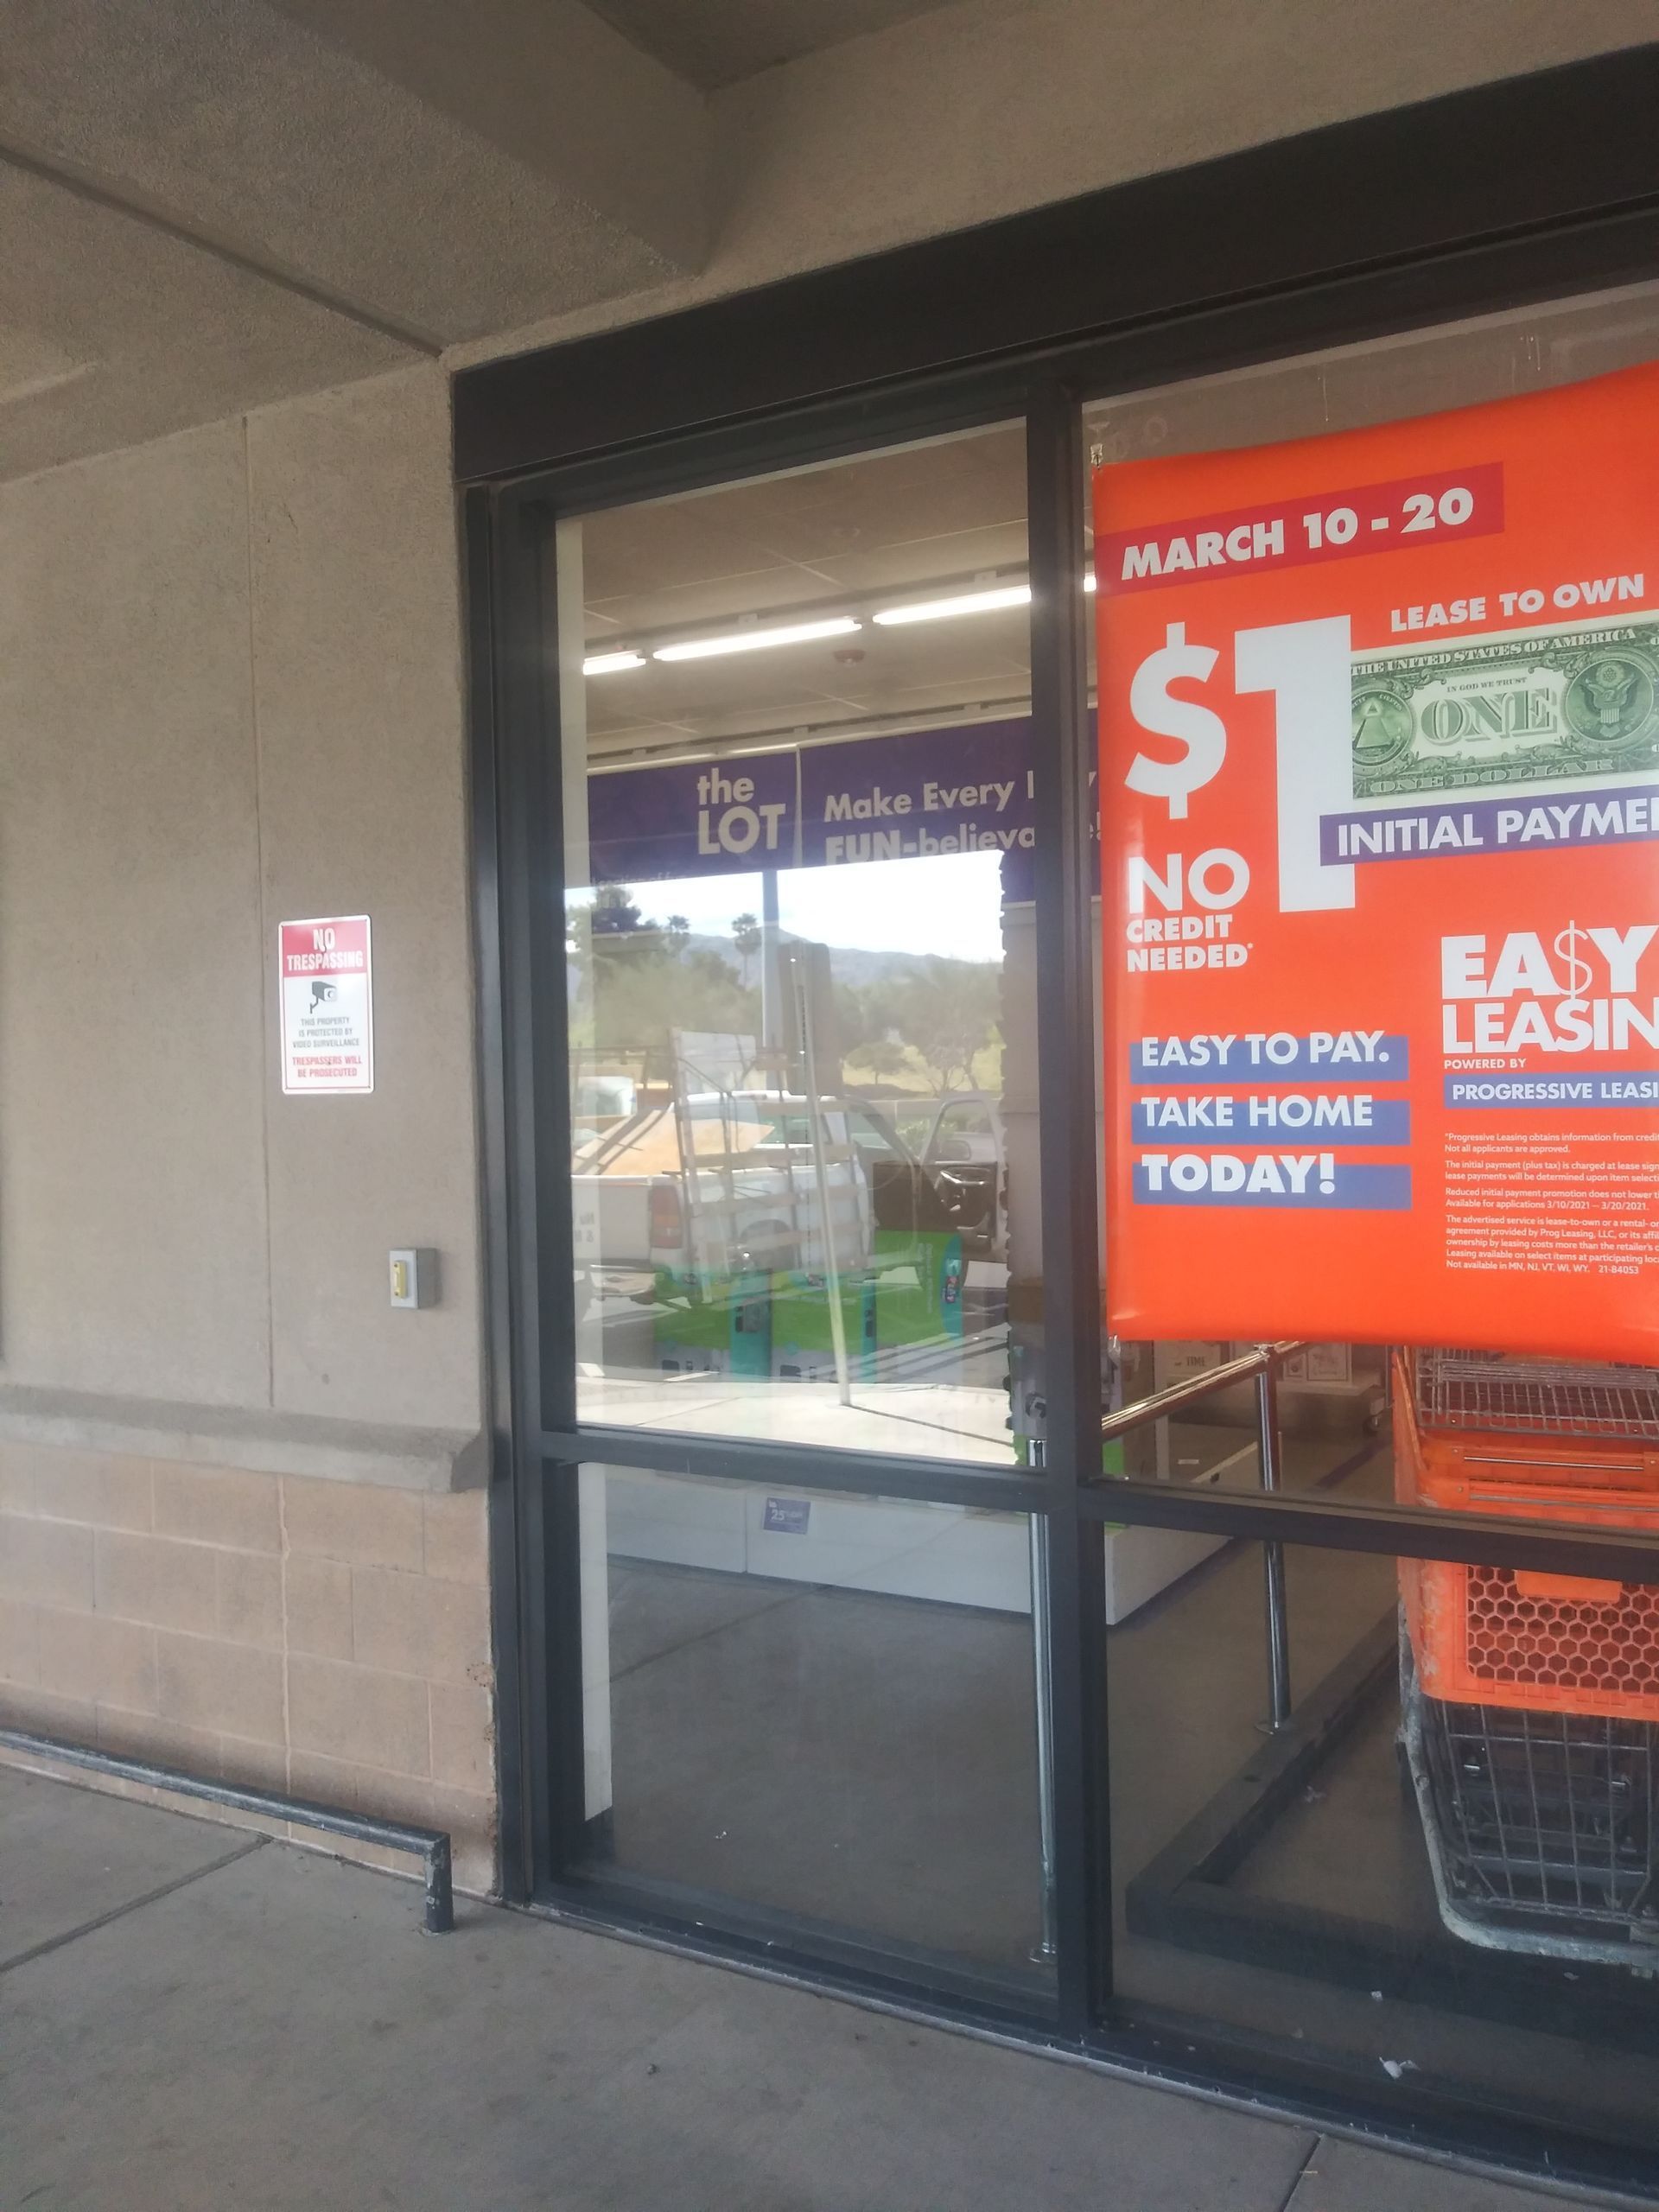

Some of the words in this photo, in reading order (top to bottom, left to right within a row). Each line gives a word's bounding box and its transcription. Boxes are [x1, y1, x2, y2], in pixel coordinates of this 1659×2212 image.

[1121, 519, 1285, 581] MARCH
[1302, 508, 1359, 550] 10
[1370, 518, 1389, 531] -
[1401, 487, 1474, 533] 20
[1390, 596, 1486, 632] LEASE
[1498, 588, 1545, 616] TO
[1552, 574, 1645, 608] OWN
[1351, 662, 1384, 675] THE
[1387, 652, 1452, 671] UNITED
[1453, 642, 1522, 662] STATES
[1523, 639, 1548, 652] OF
[1546, 628, 1637, 649] AMERICA
[1459, 683, 1479, 691] GOD
[1480, 681, 1494, 690] WE
[1495, 677, 1528, 688] TRUST
[1421, 688, 1558, 747] ONE
[1124, 614, 1356, 912] $1
[1370, 775, 1447, 793] ONE
[1452, 760, 1614, 784] DOLLAR
[697, 768, 755, 804] the
[823, 787, 913, 823] Make
[923, 775, 1015, 812] Every
[697, 804, 787, 856] LOT
[1338, 807, 1484, 855] INITIAL
[1128, 849, 1250, 914] NO
[1126, 914, 1233, 943] CREDIT
[313, 928, 335, 950] NO
[287, 950, 364, 971] TRESPASSING
[317, 1017, 350, 1026] PROPERTY
[307, 1028, 343, 1037] PROTECTED
[314, 1039, 359, 1047] SURVEILLANCE
[1141, 1035, 1236, 1067] EASY
[1245, 1033, 1299, 1065] TO
[1309, 1030, 1389, 1064] PAY.
[292, 1056, 342, 1065] TRESPASSERS
[345, 1056, 362, 1065] WILL
[1444, 1059, 1505, 1069] POWERED
[1510, 1058, 1527, 1068] BY
[298, 1069, 307, 1077] BE
[309, 1068, 357, 1077] PROSECUTED
[1452, 1083, 1592, 1100] PROGRESSIVE
[1141, 1096, 1234, 1127] TAKE
[1249, 1094, 1373, 1127] HOME
[1497, 1134, 1527, 1142] Leasing
[1613, 1133, 1634, 1141] from
[1445, 1144, 1459, 1153] Not
[1461, 1144, 1471, 1153] all
[1472, 1145, 1513, 1154] applicants
[1529, 1145, 1571, 1154] approved.
[1485, 1161, 1521, 1170] payment
[1522, 1161, 1543, 1171] (plus
[1545, 1161, 1560, 1170] tax)
[1571, 1161, 1606, 1171] charged
[1141, 1153, 1336, 1196] TODAY!
[1467, 1173, 1507, 1181] payments
[1536, 1173, 1584, 1181] determined
[1586, 1174, 1608, 1183] upon
[1505, 1189, 1541, 1198] payment
[1543, 1189, 1586, 1198] promotion
[1589, 1190, 1609, 1198] does
[1628, 1191, 1651, 1199] lower
[1446, 1199, 1481, 1208] Available
[1497, 1201, 1545, 1210] applications
[1548, 1201, 1590, 1210] 3/10/2021
[1546, 1217, 1600, 1226] lease-to-own
[1446, 1227, 1490, 1236] agreement
[1491, 1228, 1527, 1236] provided
[1529, 1229, 1538, 1237] by
[1541, 1229, 1559, 1238] Prog
[1446, 1238, 1487, 1247] ownership
[1489, 1239, 1499, 1248] by
[1501, 1239, 1530, 1249] leasing
[1579, 1241, 1599, 1249] than
[1446, 1249, 1477, 1259] Leasing
[1478, 1250, 1513, 1259] available
[1527, 1251, 1551, 1260] select
[1554, 1252, 1576, 1261] items
[1589, 1253, 1643, 1264] participating
[1464, 1261, 1497, 1269] available
